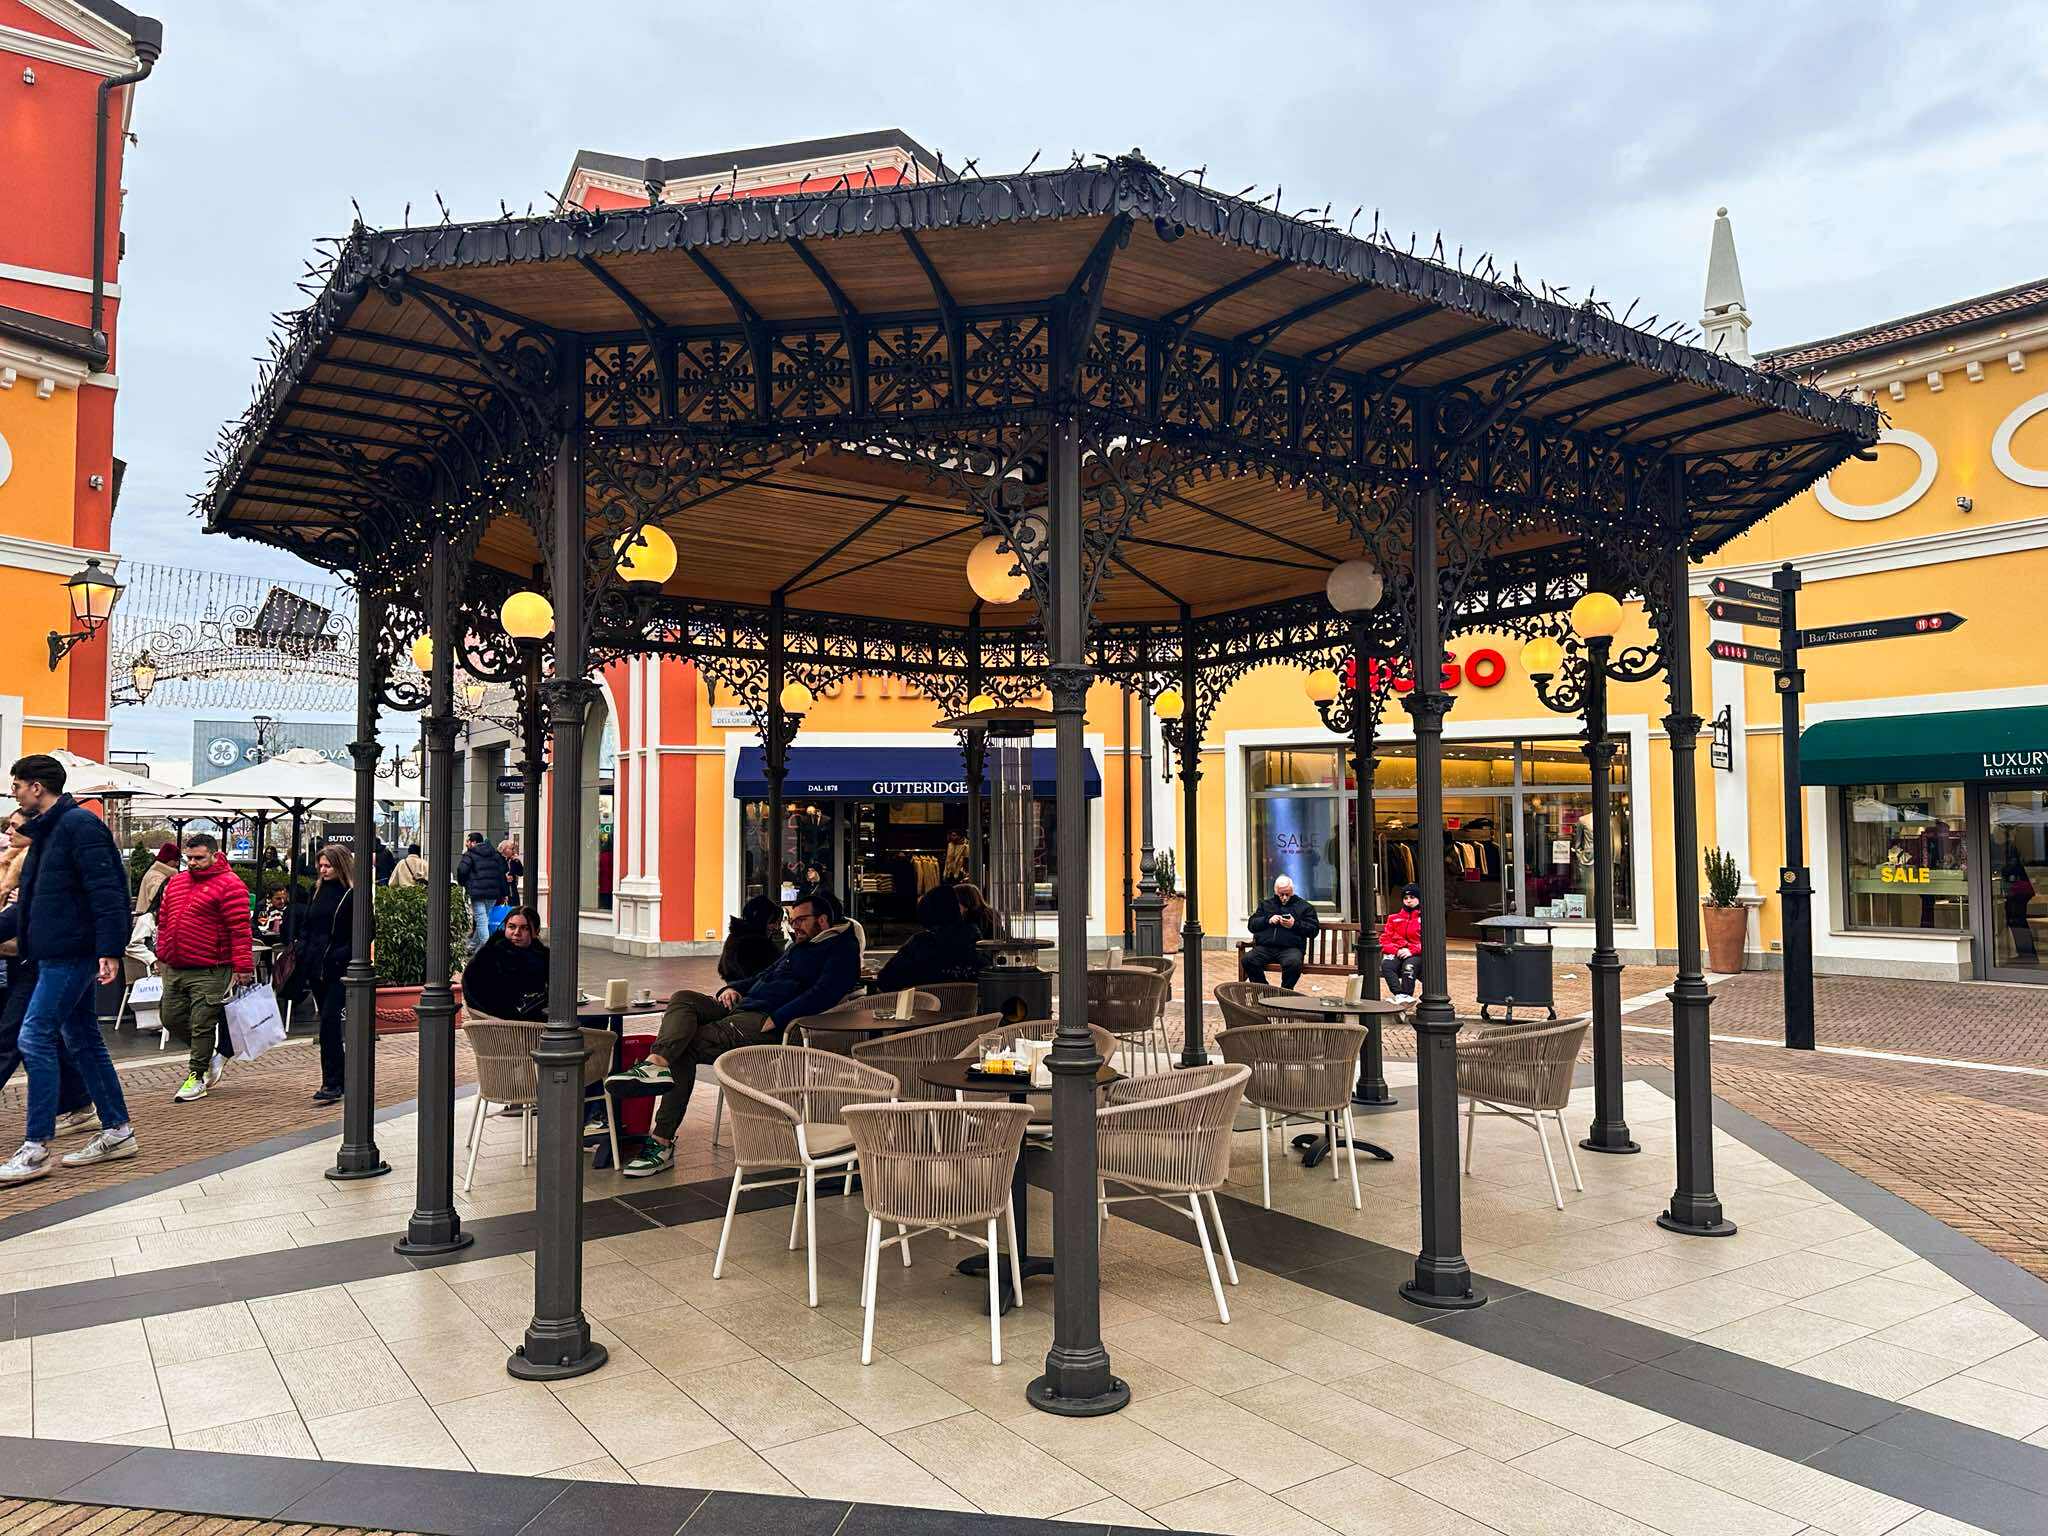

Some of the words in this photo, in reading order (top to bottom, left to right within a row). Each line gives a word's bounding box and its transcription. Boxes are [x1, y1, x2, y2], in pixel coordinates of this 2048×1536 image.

[1808, 628, 1878, 644] Bar/Ristorante
[1985, 767, 2042, 777] JEWELLERY
[872, 781, 969, 794] GUTTERIDGE
[1880, 866, 1931, 883] SALE
